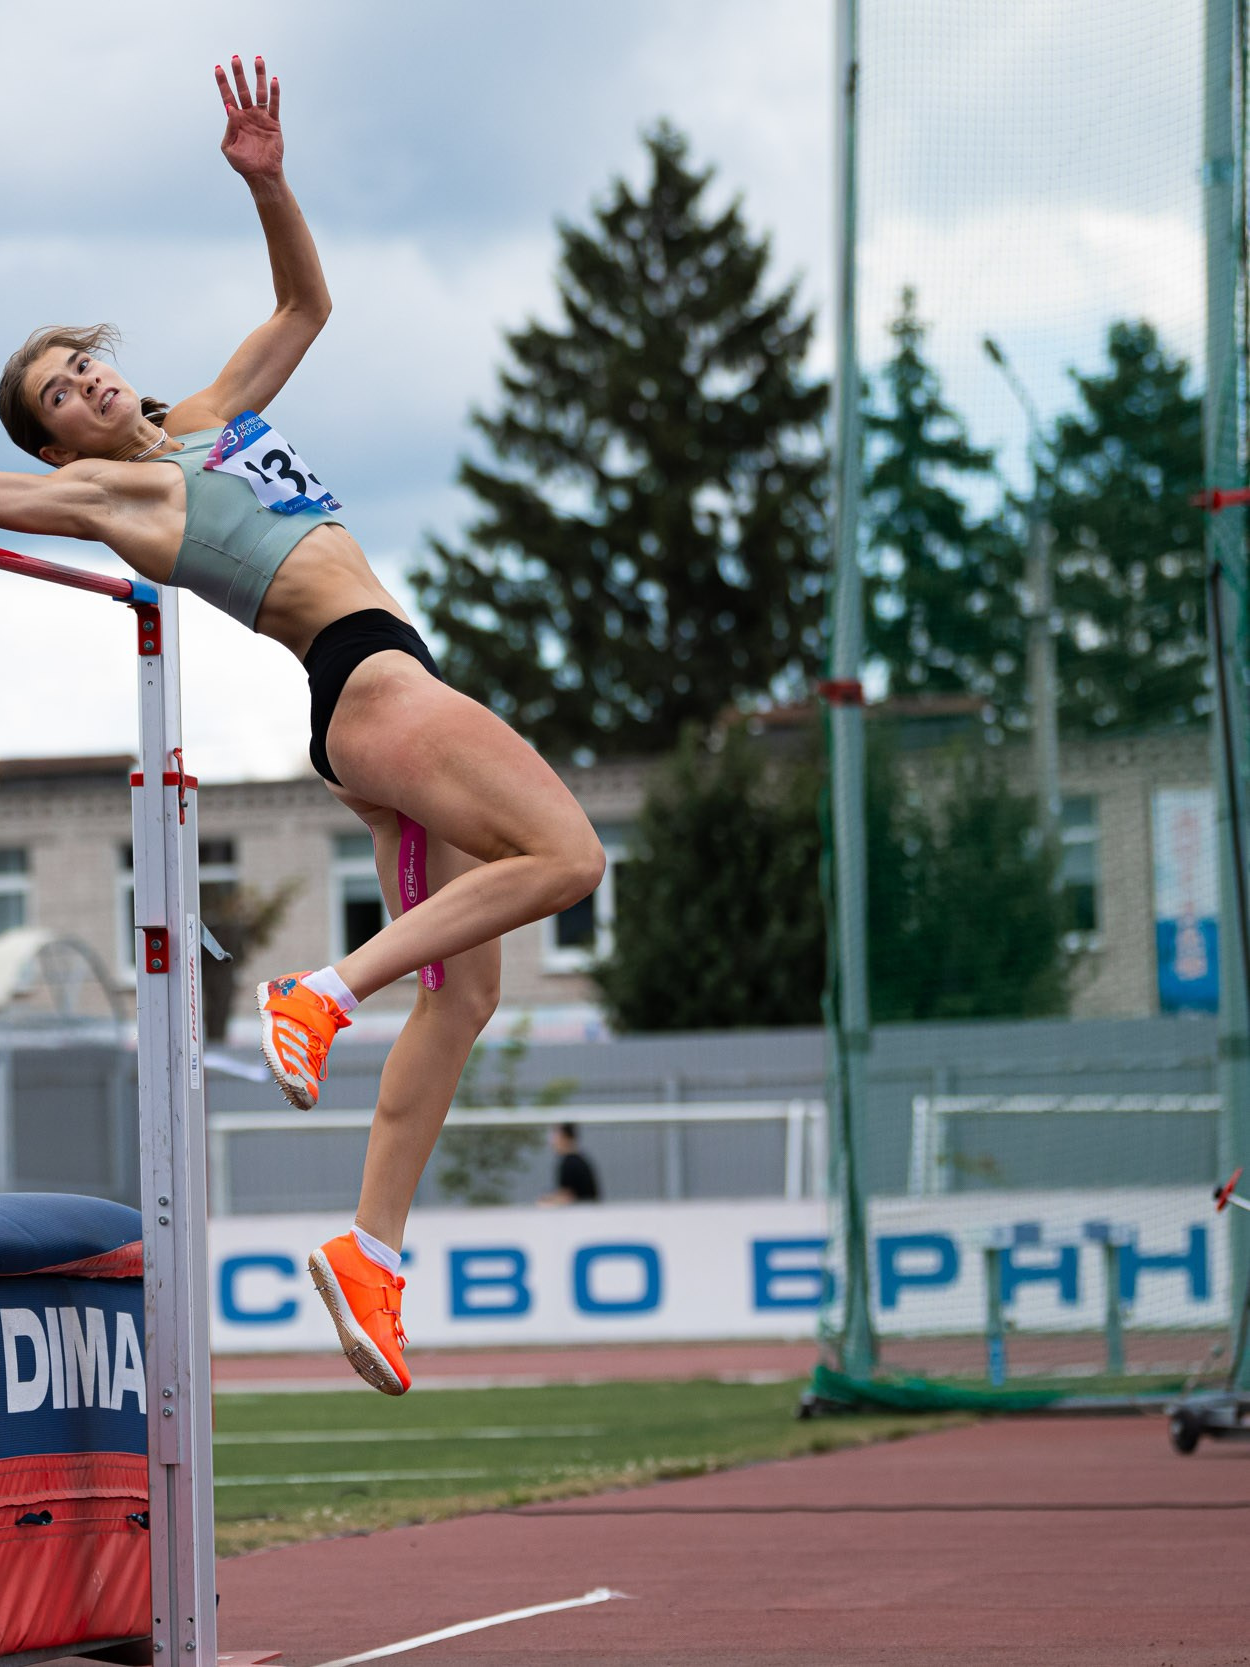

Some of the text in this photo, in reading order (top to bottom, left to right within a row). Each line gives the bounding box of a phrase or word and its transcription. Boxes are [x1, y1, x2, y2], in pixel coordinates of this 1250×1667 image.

[189, 955, 197, 1043] polanik
[218, 1243, 663, 1324] СВО
[0, 1306, 147, 1415] DIMA
